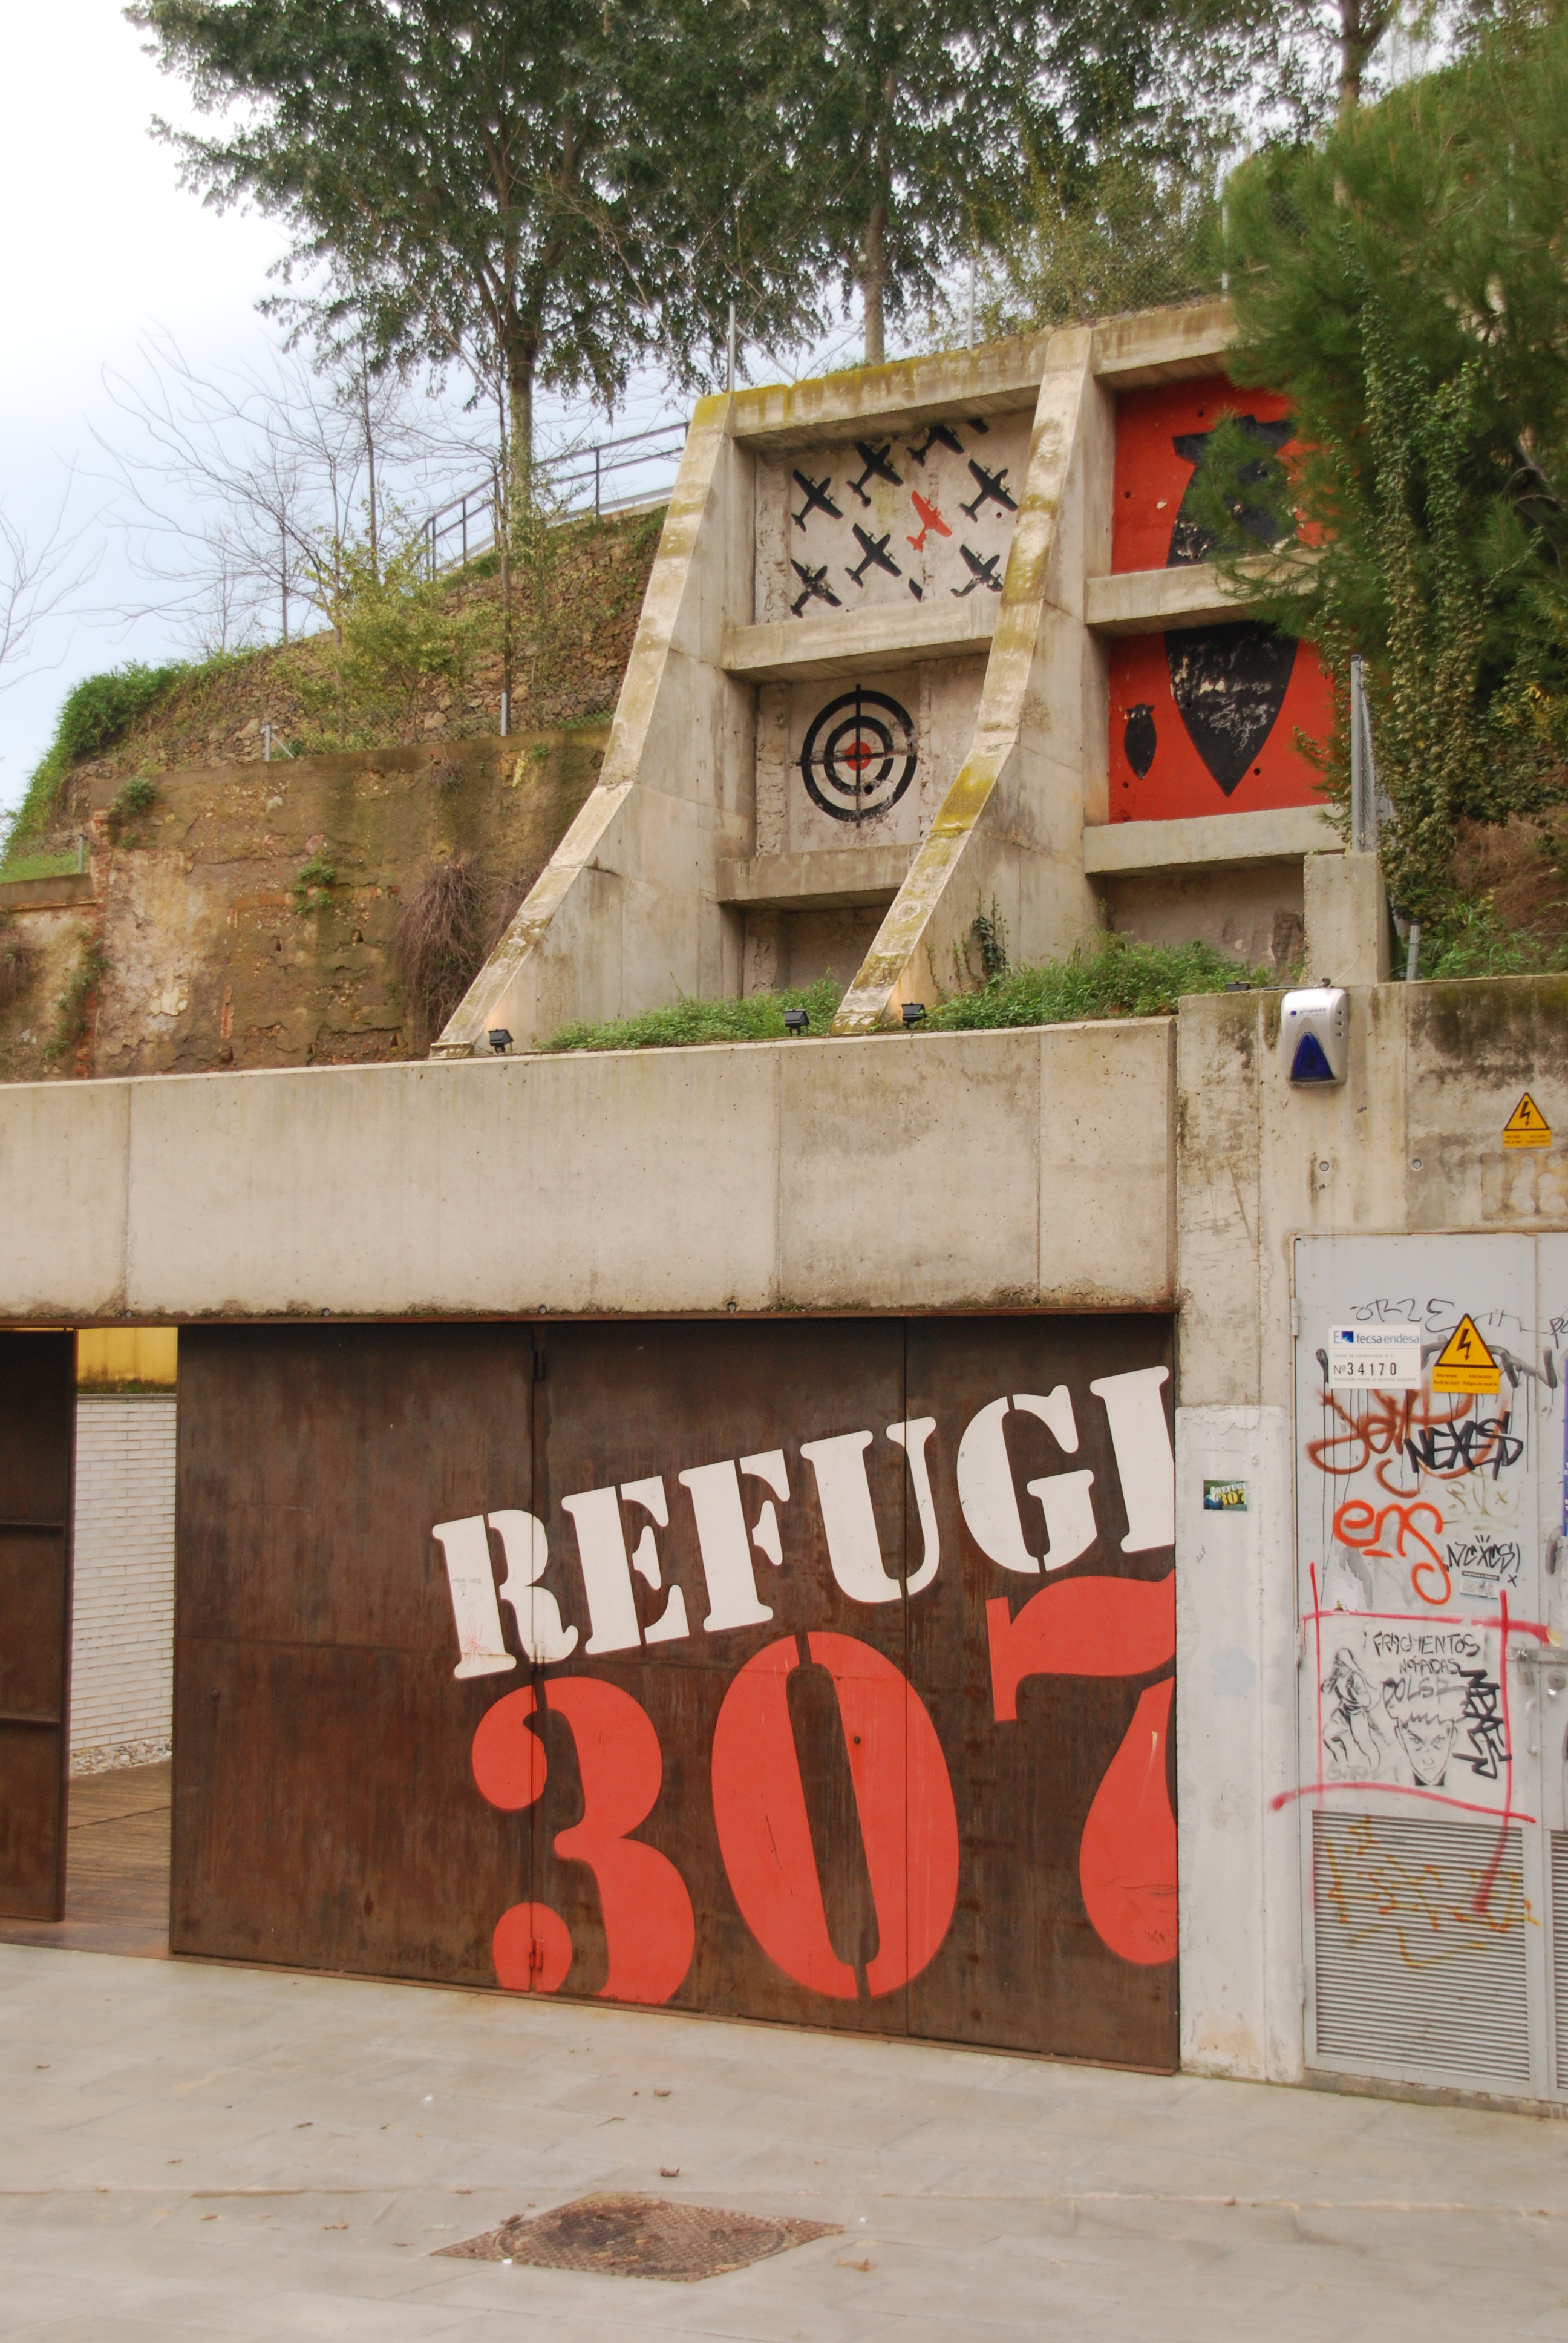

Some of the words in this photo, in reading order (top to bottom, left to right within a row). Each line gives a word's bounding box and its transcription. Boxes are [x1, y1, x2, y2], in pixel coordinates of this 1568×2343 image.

[431, 1366, 1175, 1679] REFUGI
[1347, 1362, 1396, 1375] 34170
[471, 1568, 1178, 2005] 307
